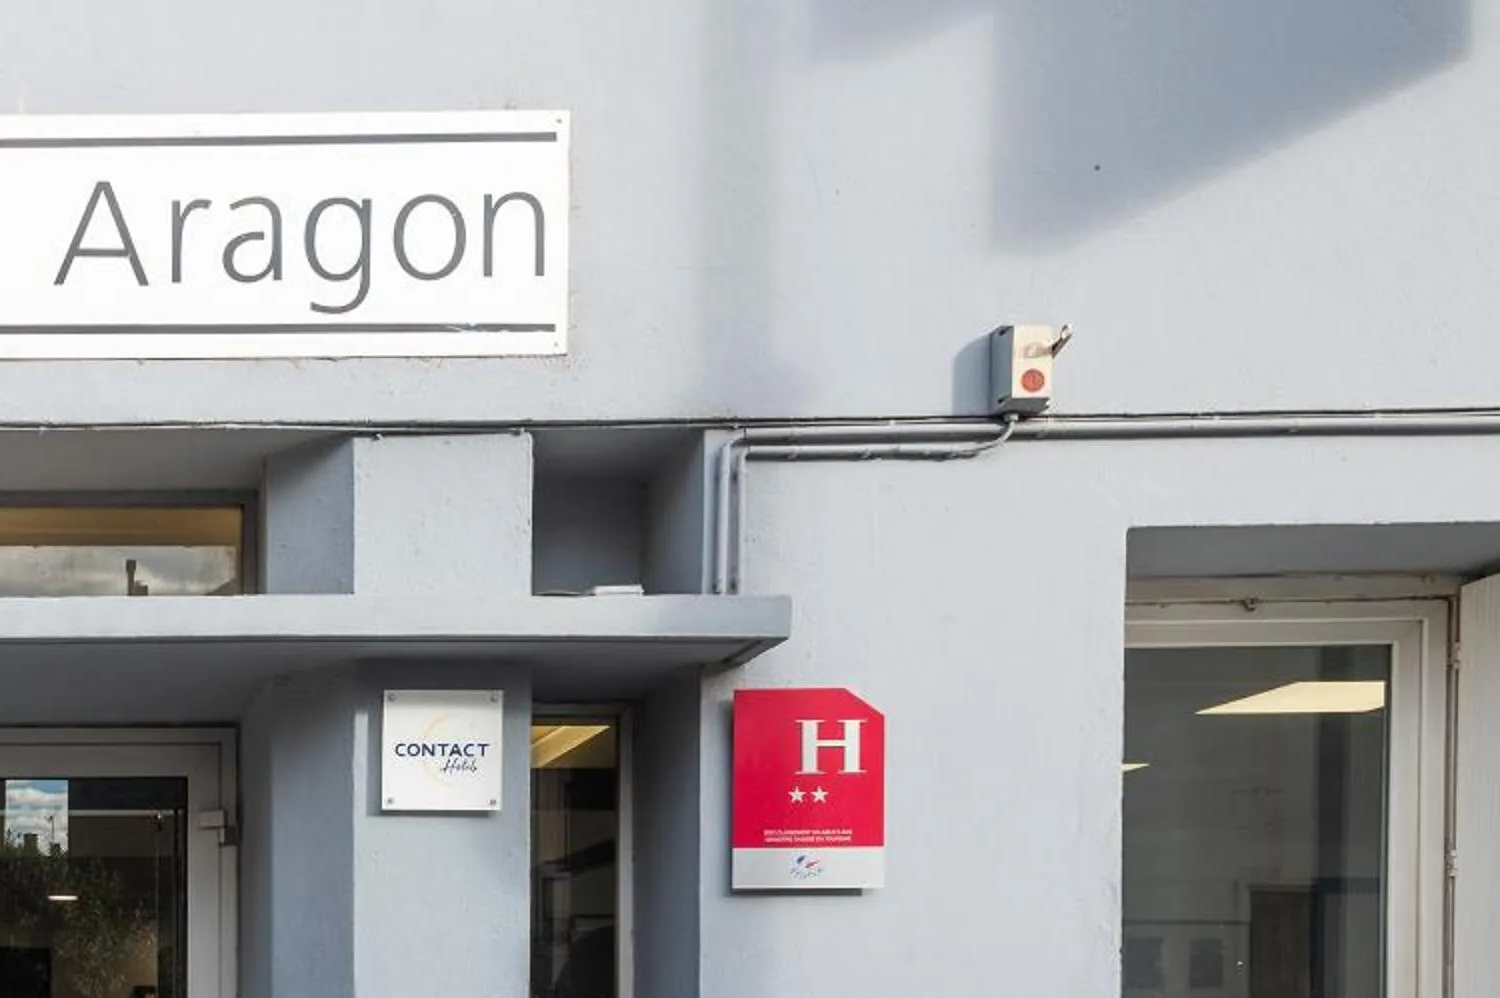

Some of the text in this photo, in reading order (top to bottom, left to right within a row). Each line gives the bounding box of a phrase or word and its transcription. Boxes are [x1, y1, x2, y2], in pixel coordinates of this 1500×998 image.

[53, 178, 545, 315] Aragon
[394, 743, 490, 757] CONTACT
[794, 718, 868, 776] H
